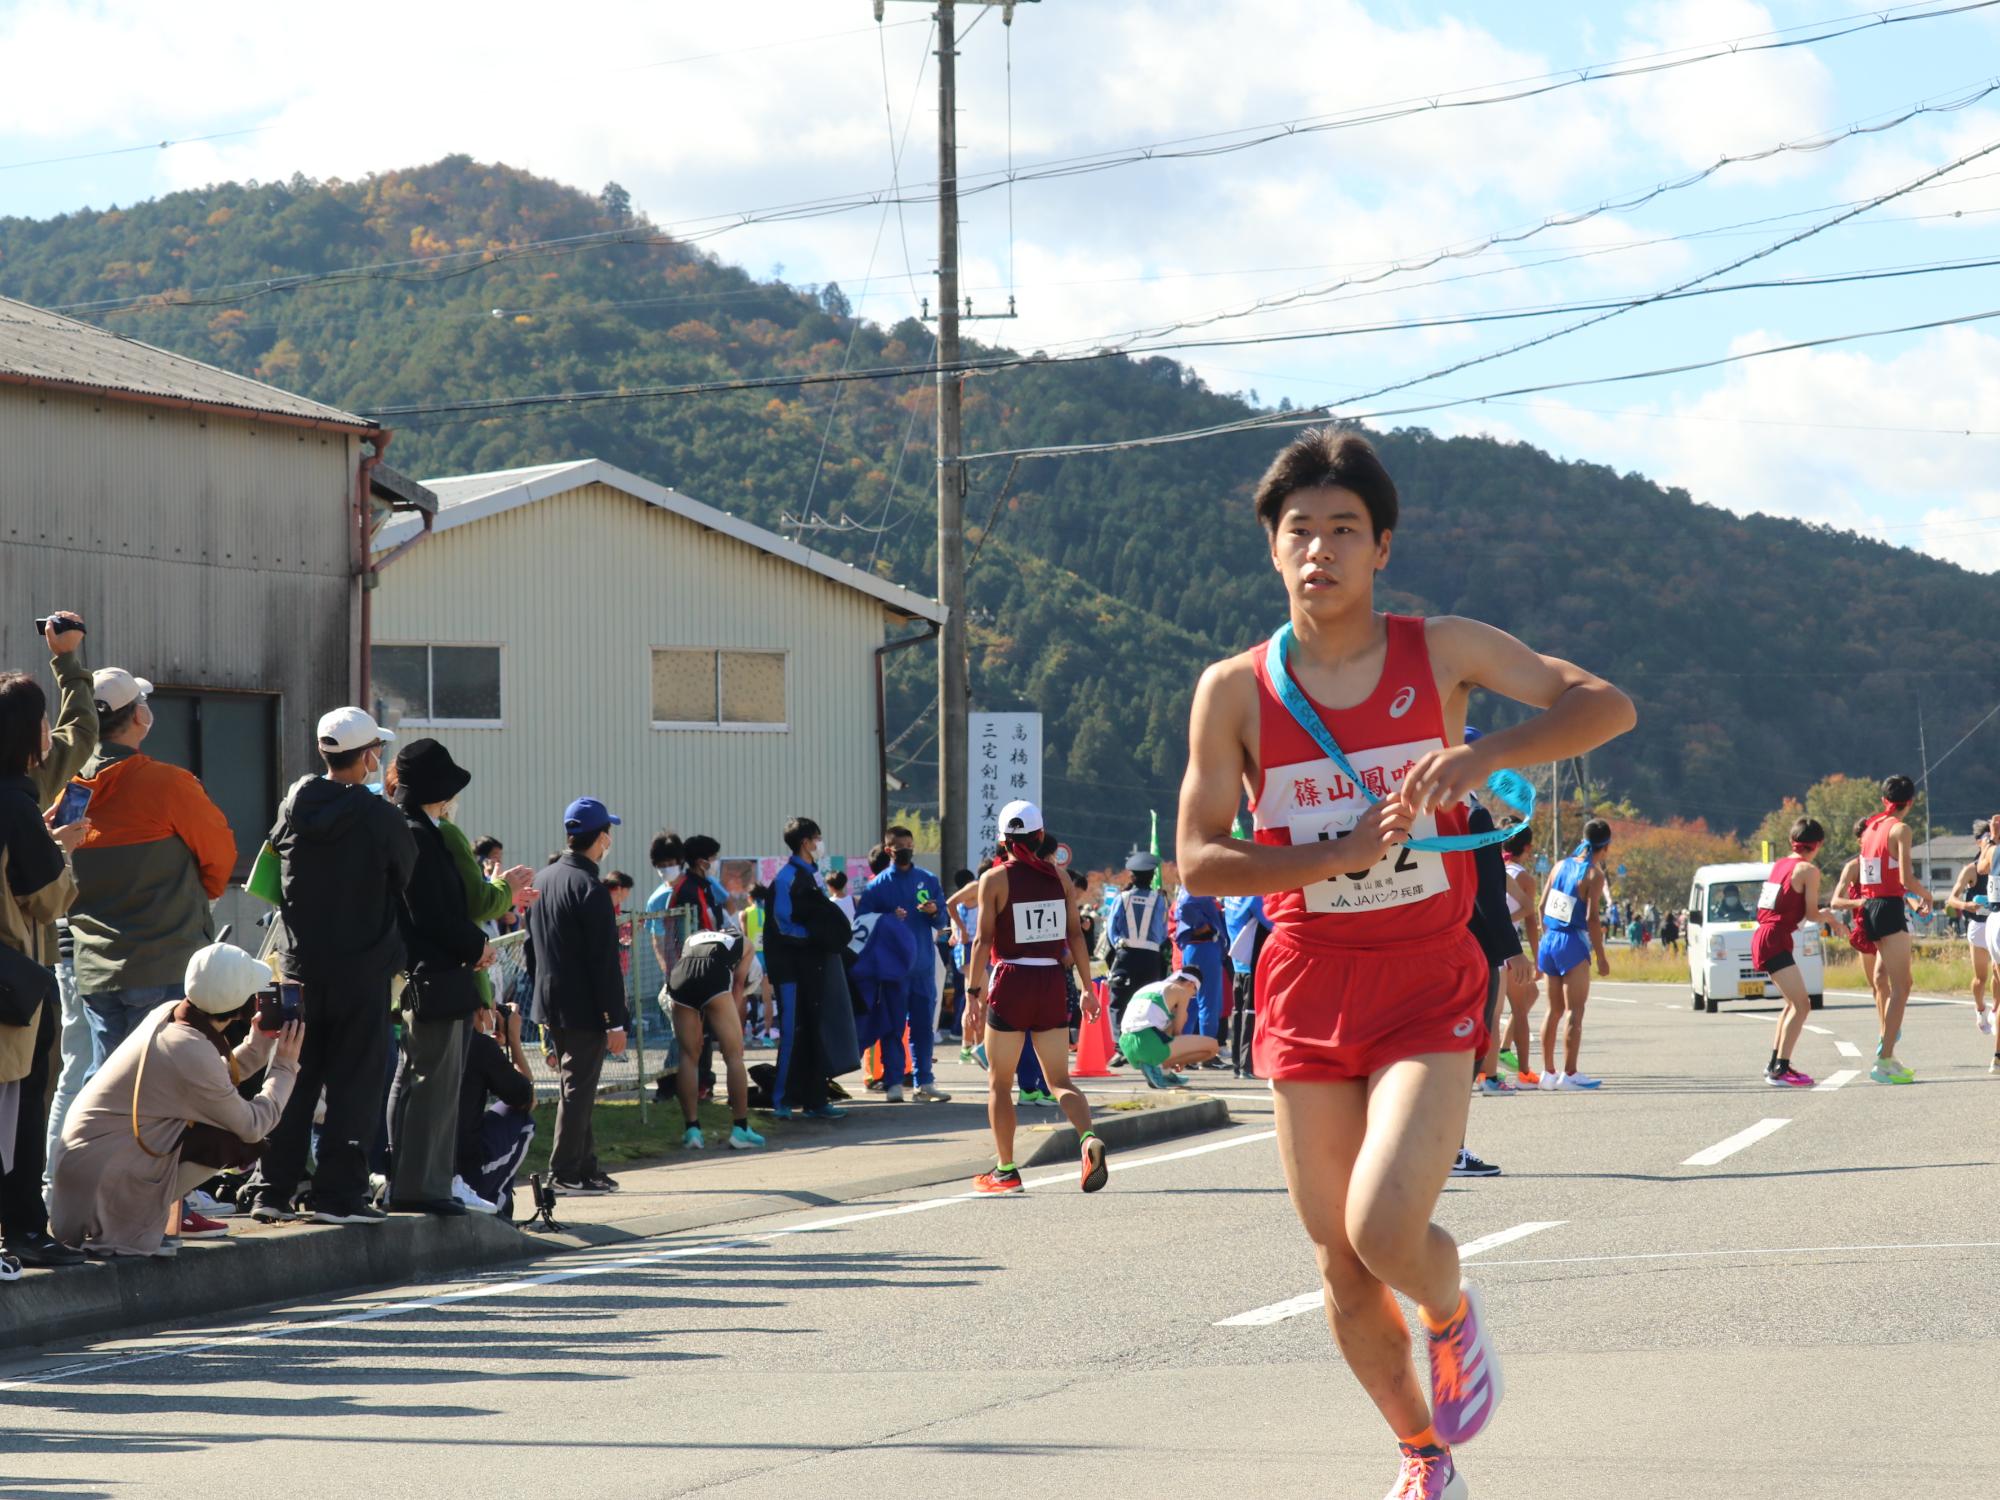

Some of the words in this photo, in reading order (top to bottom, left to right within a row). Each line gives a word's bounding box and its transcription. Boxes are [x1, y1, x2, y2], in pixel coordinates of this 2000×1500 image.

[1010, 723, 1028, 801] 高橋勝
[1354, 884, 1424, 906] JAバンク兵庫
[1026, 909, 1057, 930] 17-1
